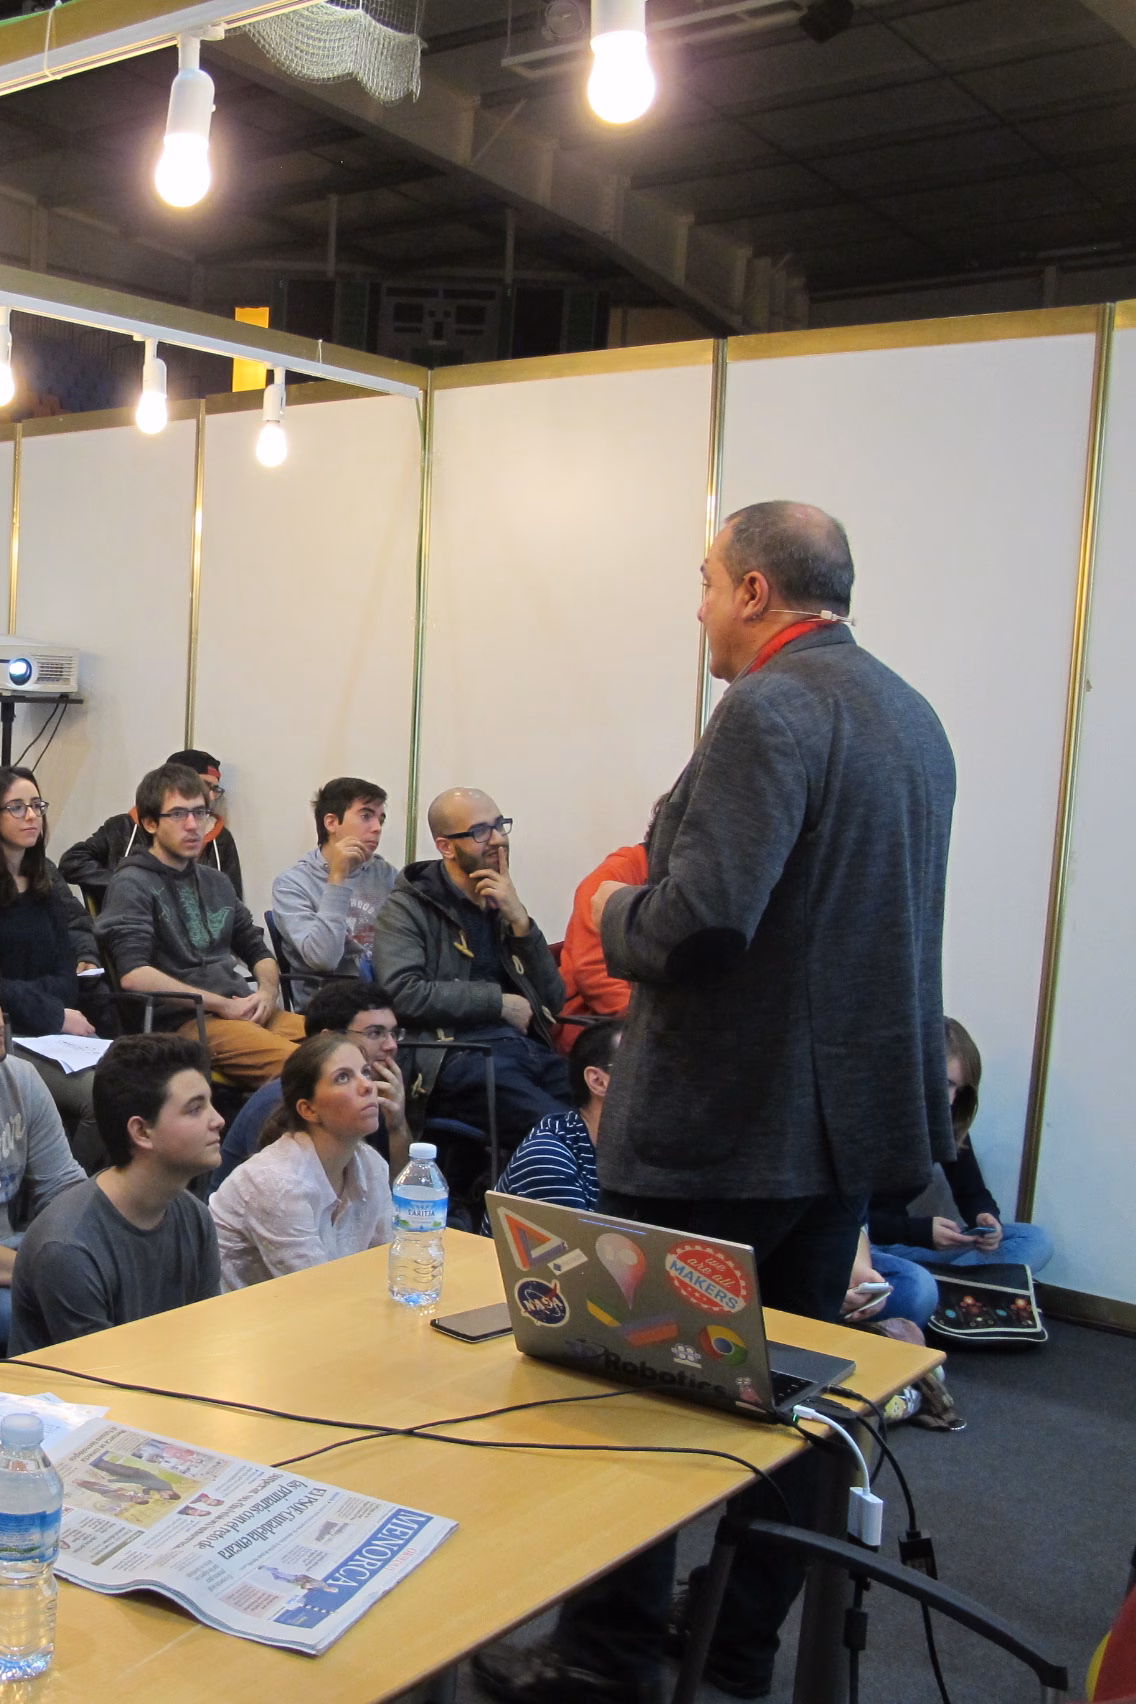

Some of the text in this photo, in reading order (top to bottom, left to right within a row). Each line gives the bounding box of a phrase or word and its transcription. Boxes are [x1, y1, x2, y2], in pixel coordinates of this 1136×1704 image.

[670, 1259, 739, 1310] MAKERS
[523, 1297, 564, 1315] NASA
[246, 1484, 293, 1514] primarias
[306, 1486, 328, 1497] El
[231, 1509, 257, 1524] con
[204, 1526, 232, 1542] reto
[192, 1539, 212, 1550] de
[215, 1535, 254, 1560] encara
[325, 1510, 430, 1592] MENORCA
